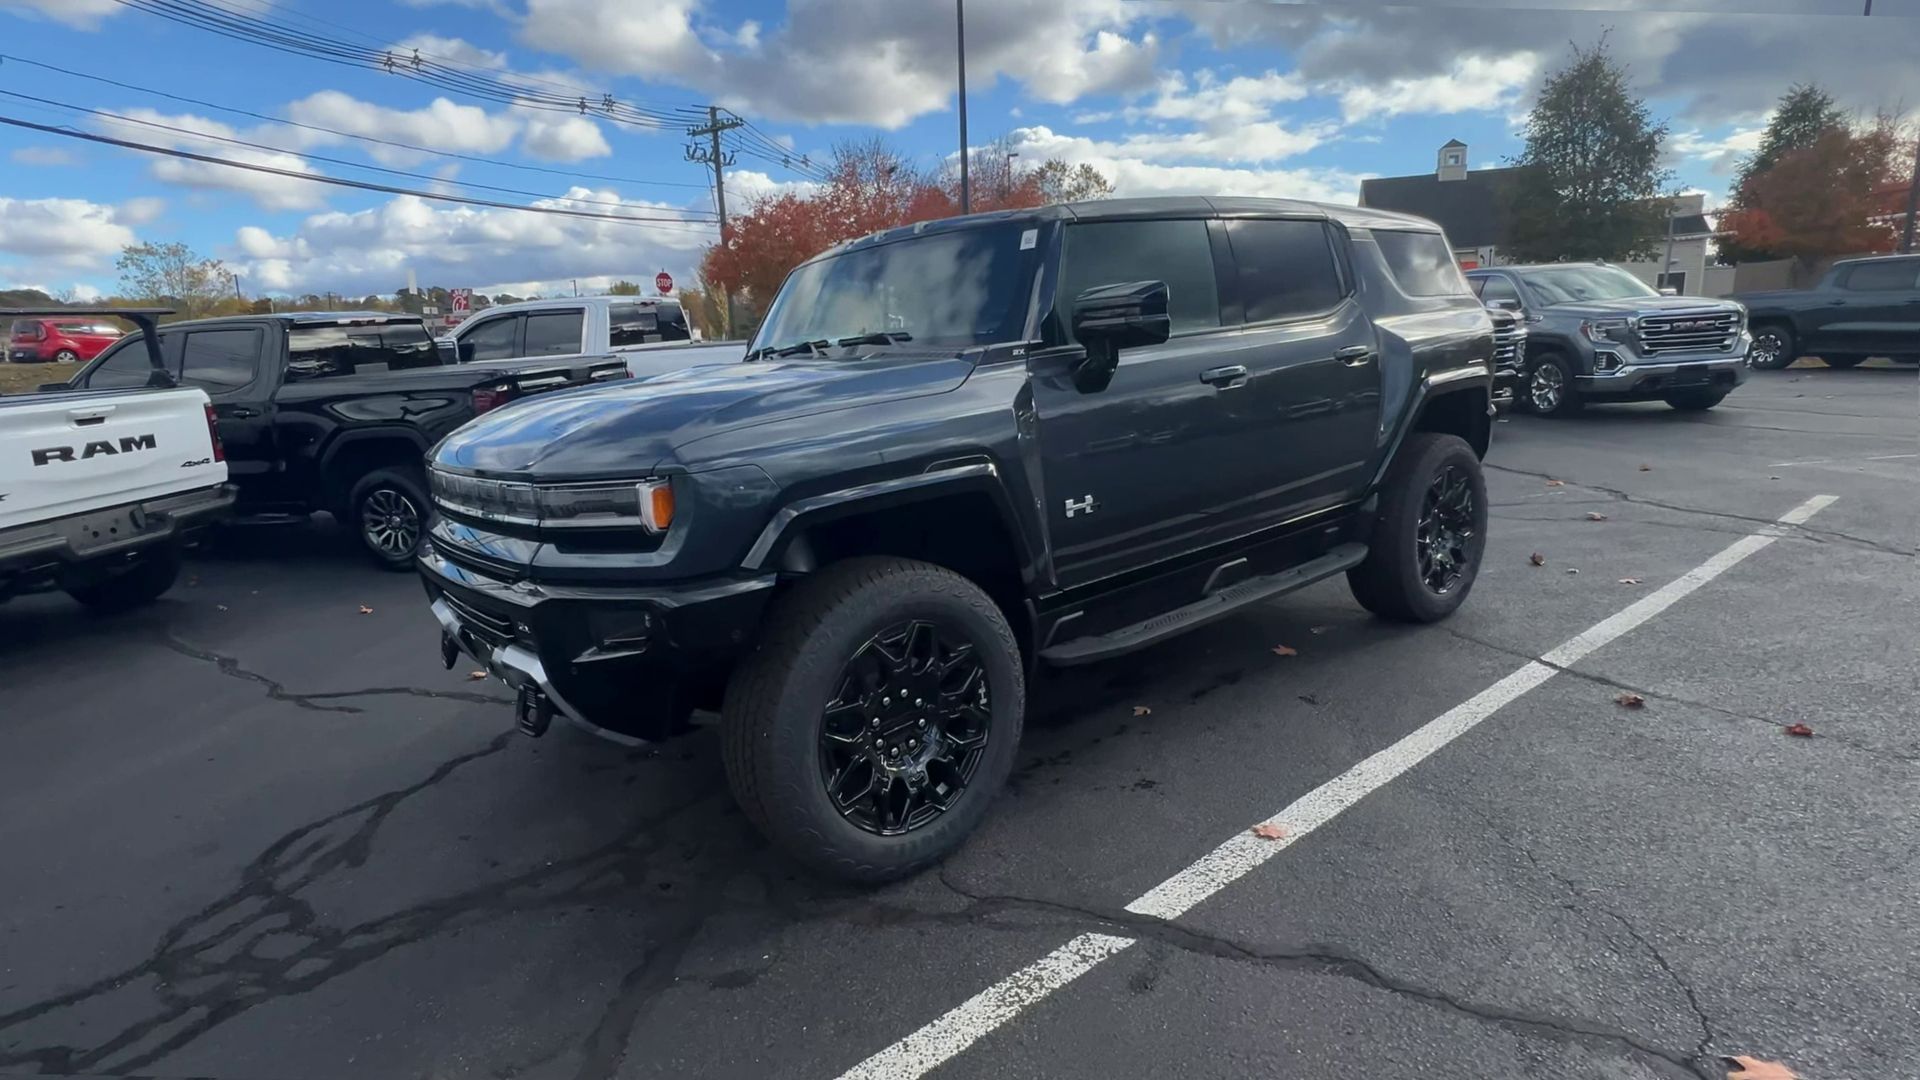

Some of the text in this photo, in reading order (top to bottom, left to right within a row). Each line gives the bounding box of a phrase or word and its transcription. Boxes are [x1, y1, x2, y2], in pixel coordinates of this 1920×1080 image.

[656, 278, 672, 288] STOP
[1672, 319, 1716, 331] GMC
[30, 433, 157, 467] RAM
